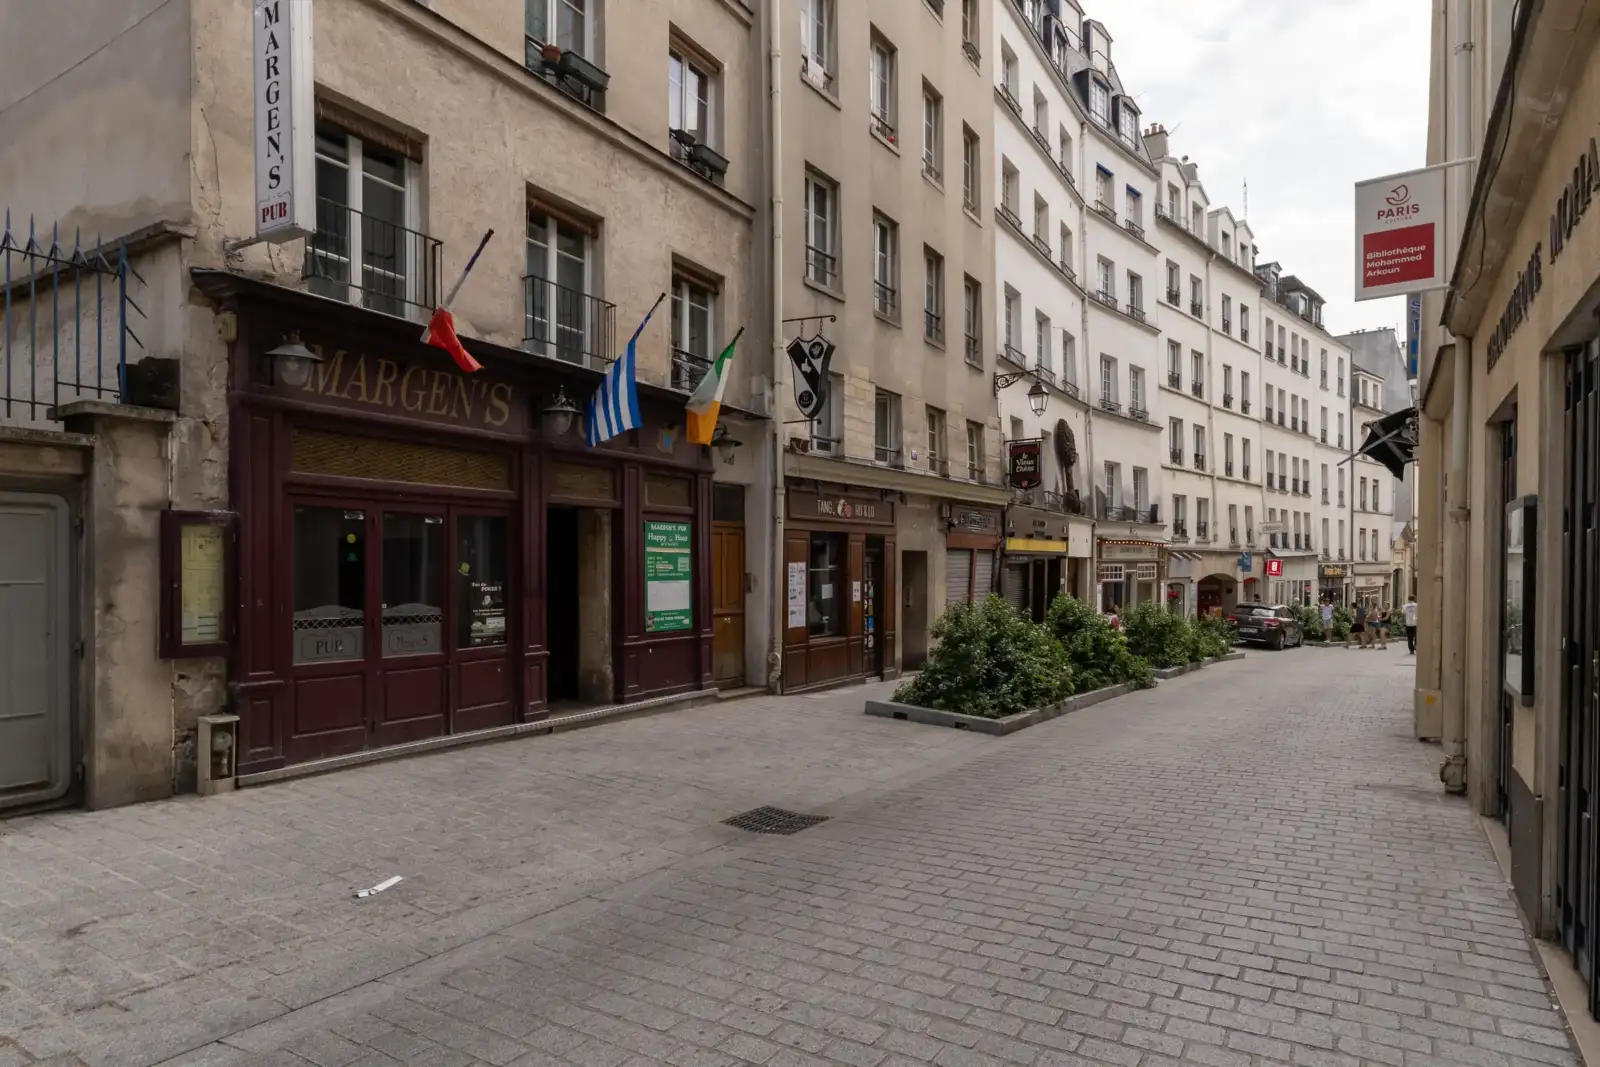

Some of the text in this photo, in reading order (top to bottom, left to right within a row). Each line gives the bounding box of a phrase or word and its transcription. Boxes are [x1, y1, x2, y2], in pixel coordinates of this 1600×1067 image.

[263, 0, 285, 190] MARGEN'S
[261, 201, 287, 223] PUB
[1377, 203, 1420, 220] PARIS
[1366, 244, 1426, 260] Bibliothèque
[1366, 253, 1422, 269] Mohammed
[1366, 267, 1400, 278] Arkoun
[302, 344, 513, 426] MARGEN'S
[648, 532, 688, 542] Happy Hour
[315, 638, 344, 655] PUB
